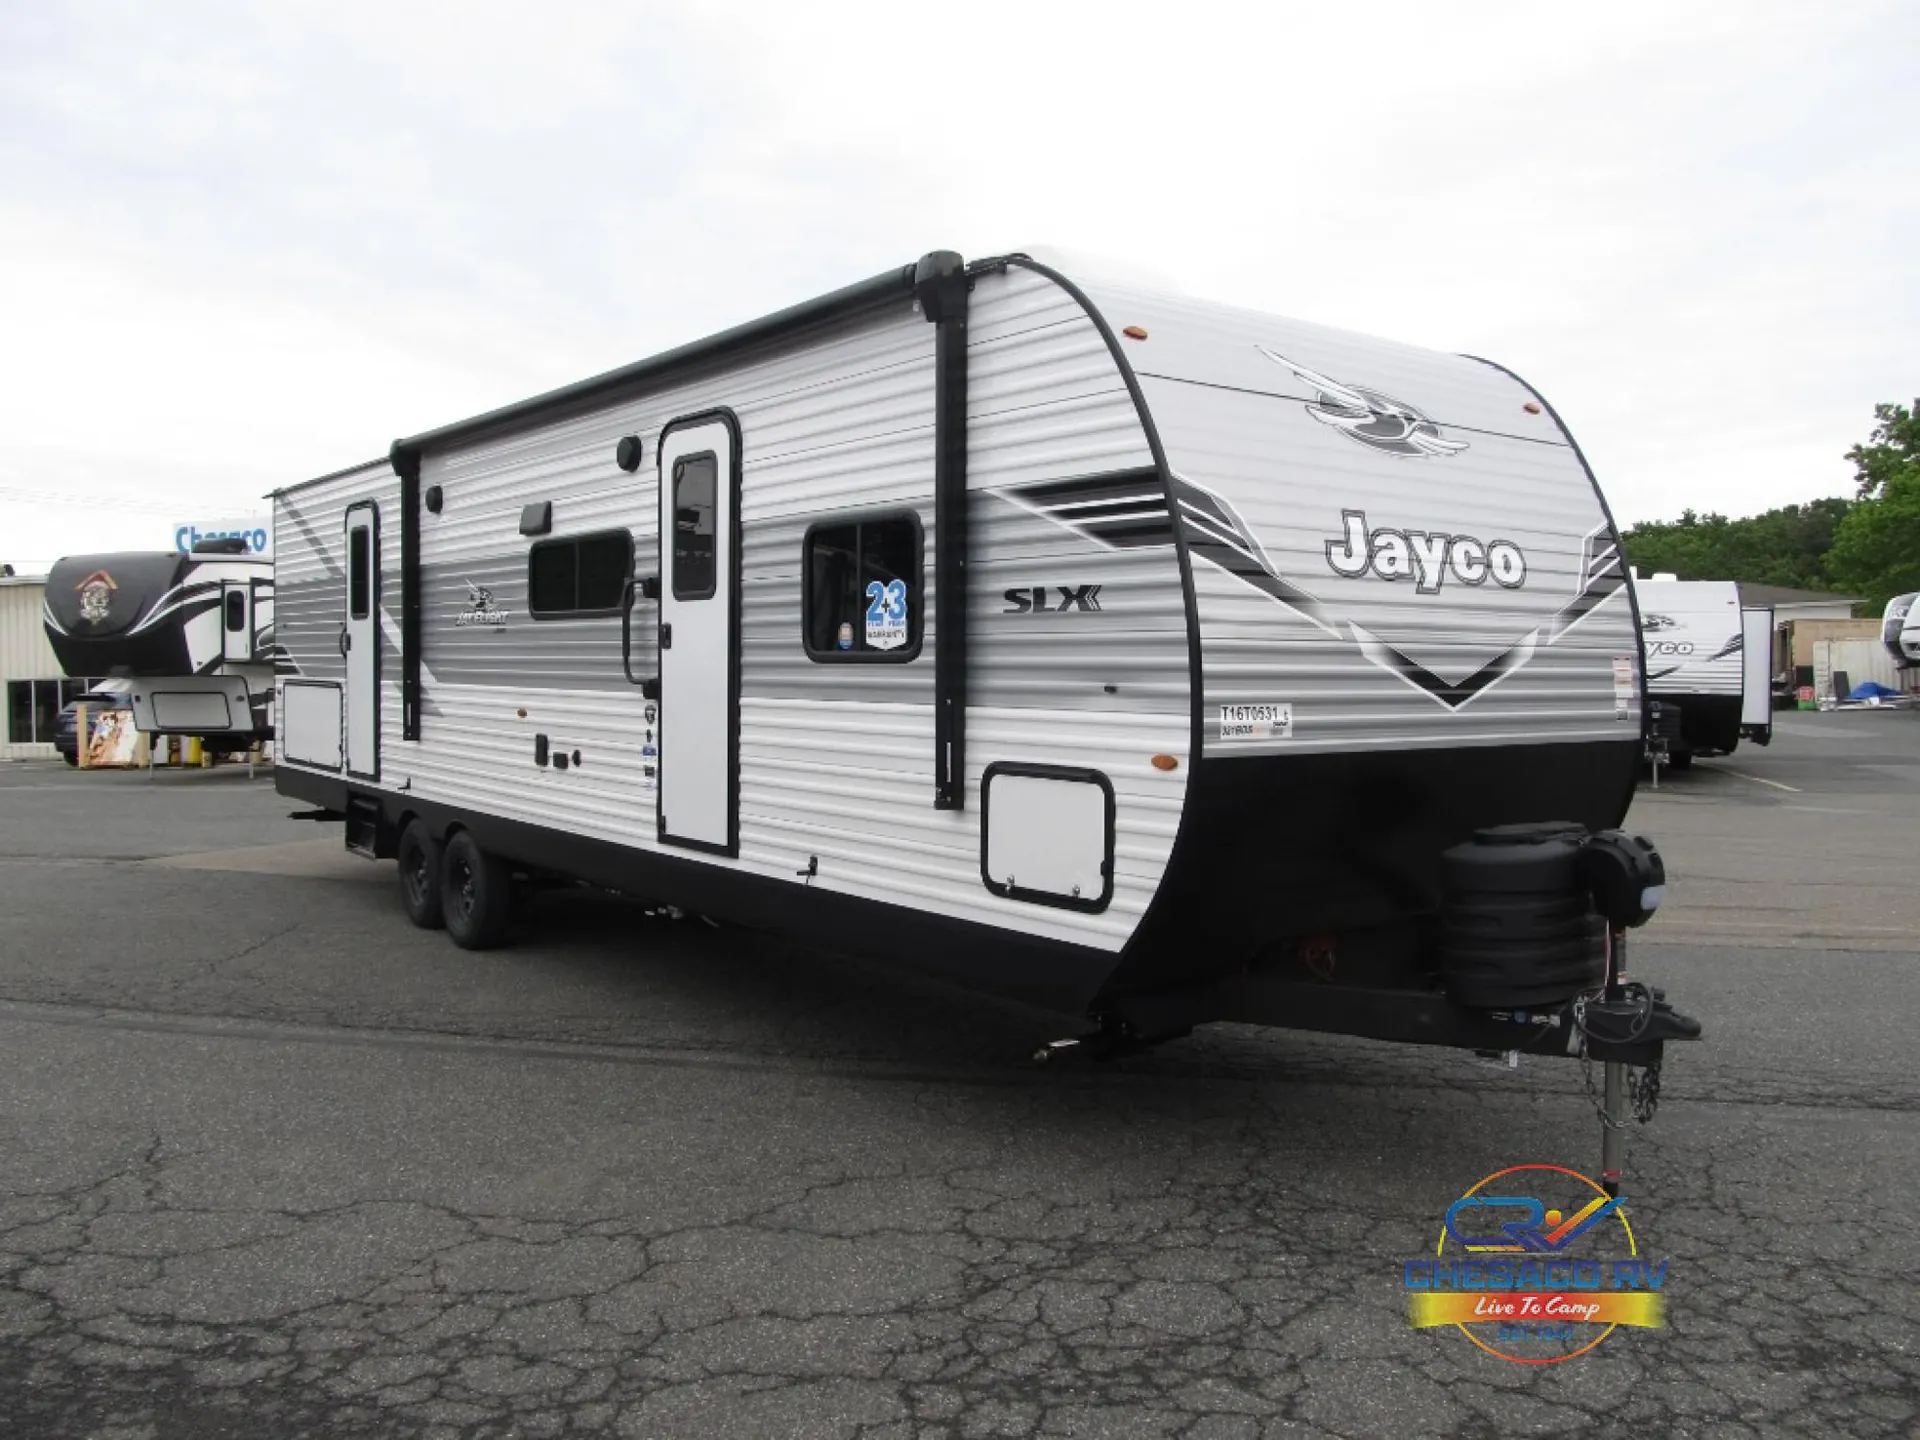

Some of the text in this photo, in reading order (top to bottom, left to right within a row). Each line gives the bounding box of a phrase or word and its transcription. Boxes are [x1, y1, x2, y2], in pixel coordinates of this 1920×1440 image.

[175, 526, 267, 553] Chco
[1324, 508, 1527, 595] Jayco
[1003, 585, 1102, 614] SLX
[1643, 641, 1694, 658] yco
